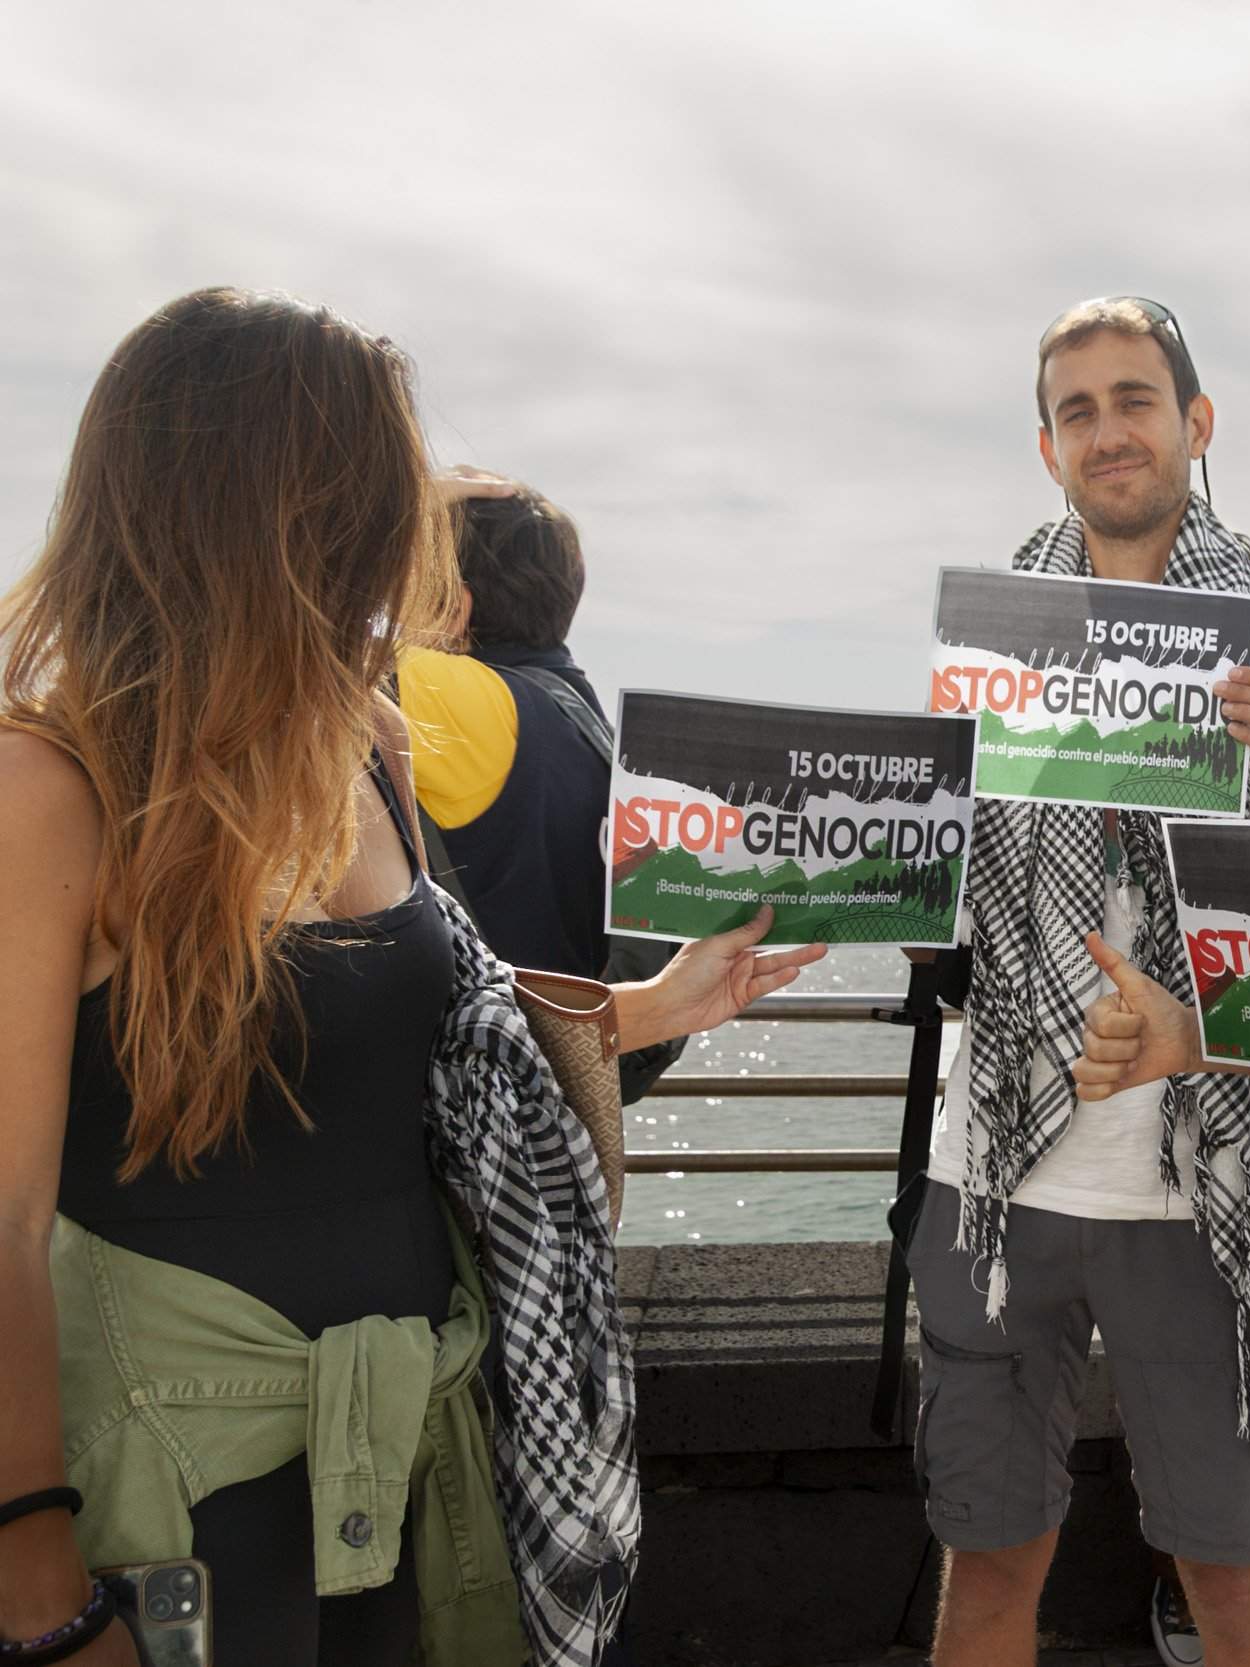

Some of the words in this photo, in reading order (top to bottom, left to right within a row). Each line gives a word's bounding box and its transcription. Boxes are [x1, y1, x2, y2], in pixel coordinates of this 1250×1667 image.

[1086, 619, 1107, 644] 15
[1111, 621, 1219, 652] OCTUBRE
[937, 665, 1232, 727] STOPGENOCIDI
[789, 750, 812, 777] 15
[817, 752, 934, 784] OCTUBRE
[997, 742, 1007, 755] al
[1007, 744, 1057, 759] genocidio
[1058, 747, 1092, 761] contra
[1093, 749, 1103, 761] el
[1103, 751, 1138, 766] pueblo
[1140, 753, 1190, 769] palestino!
[693, 883, 704, 897] al
[705, 888, 759, 902] genocidio
[761, 889, 798, 904] contra
[799, 891, 809, 904] el
[809, 890, 846, 907] pueblo
[847, 890, 901, 906] palestino!
